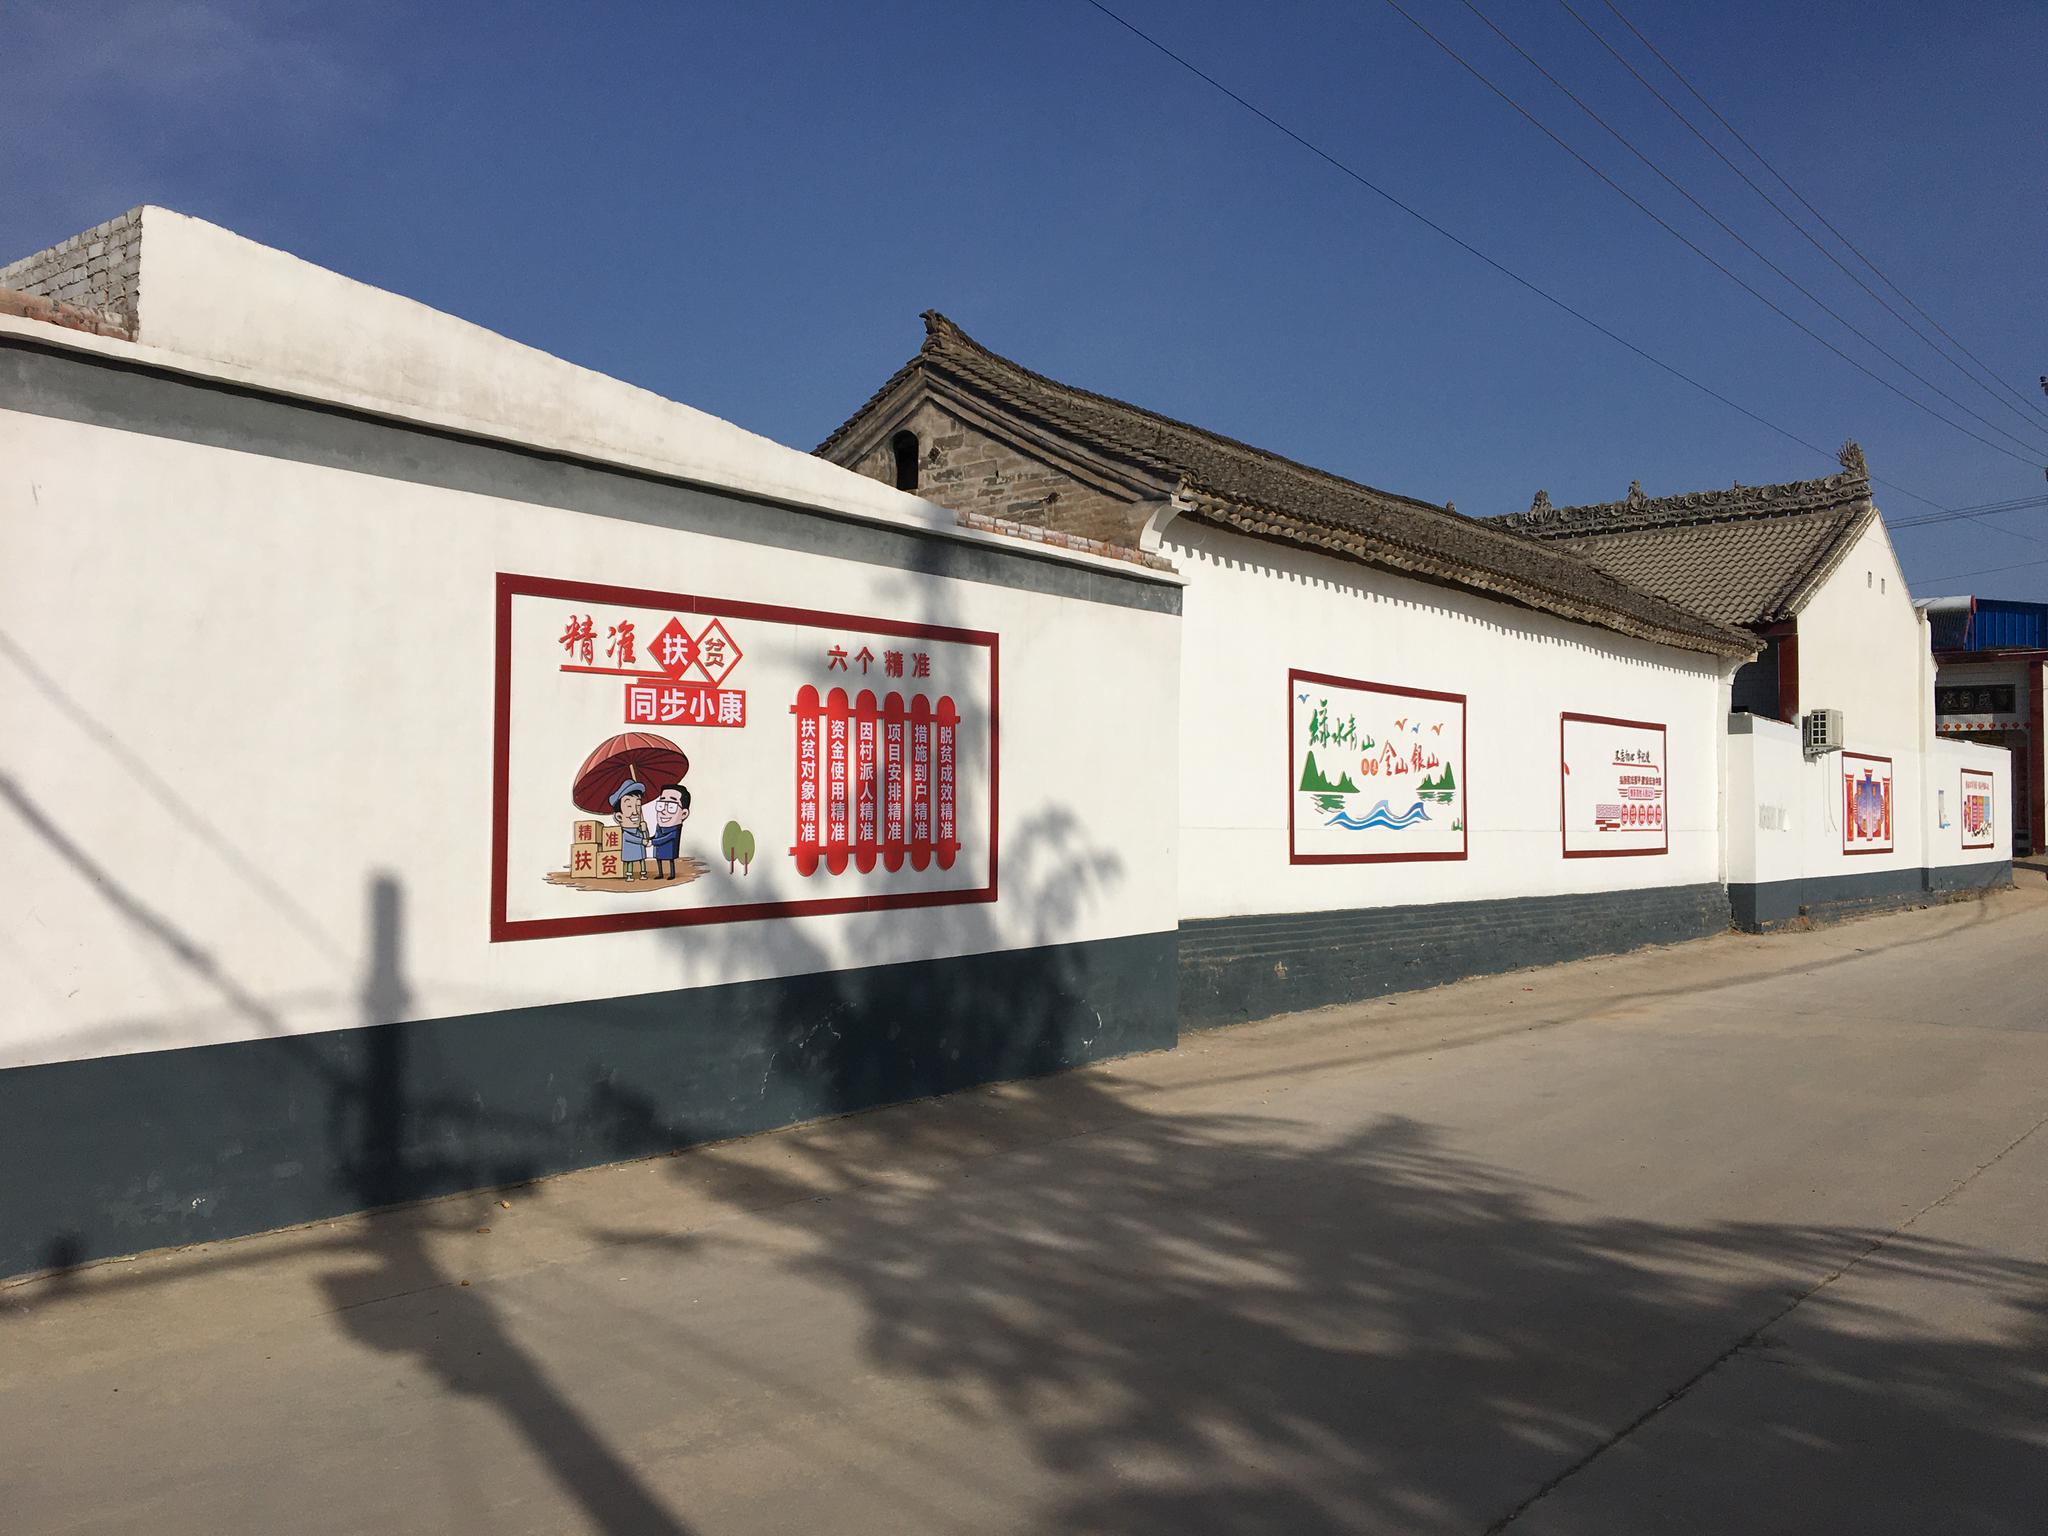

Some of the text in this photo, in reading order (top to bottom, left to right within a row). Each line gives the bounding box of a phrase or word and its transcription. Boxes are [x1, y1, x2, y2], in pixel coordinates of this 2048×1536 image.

[558, 614, 726, 669] 精准扶贫
[827, 645, 930, 678] 六个精准
[630, 687, 743, 725] 同步小康
[578, 824, 619, 848] 精准
[801, 718, 816, 842] 扶贫对象精准
[831, 720, 845, 842] 资金使用精准
[860, 722, 873, 841] 因村派人精准
[888, 723, 901, 841] 项目安排精准
[915, 724, 927, 840] 措施到户精准
[940, 726, 953, 840] 脱贫成效精准
[574, 850, 618, 875] 扶贫
